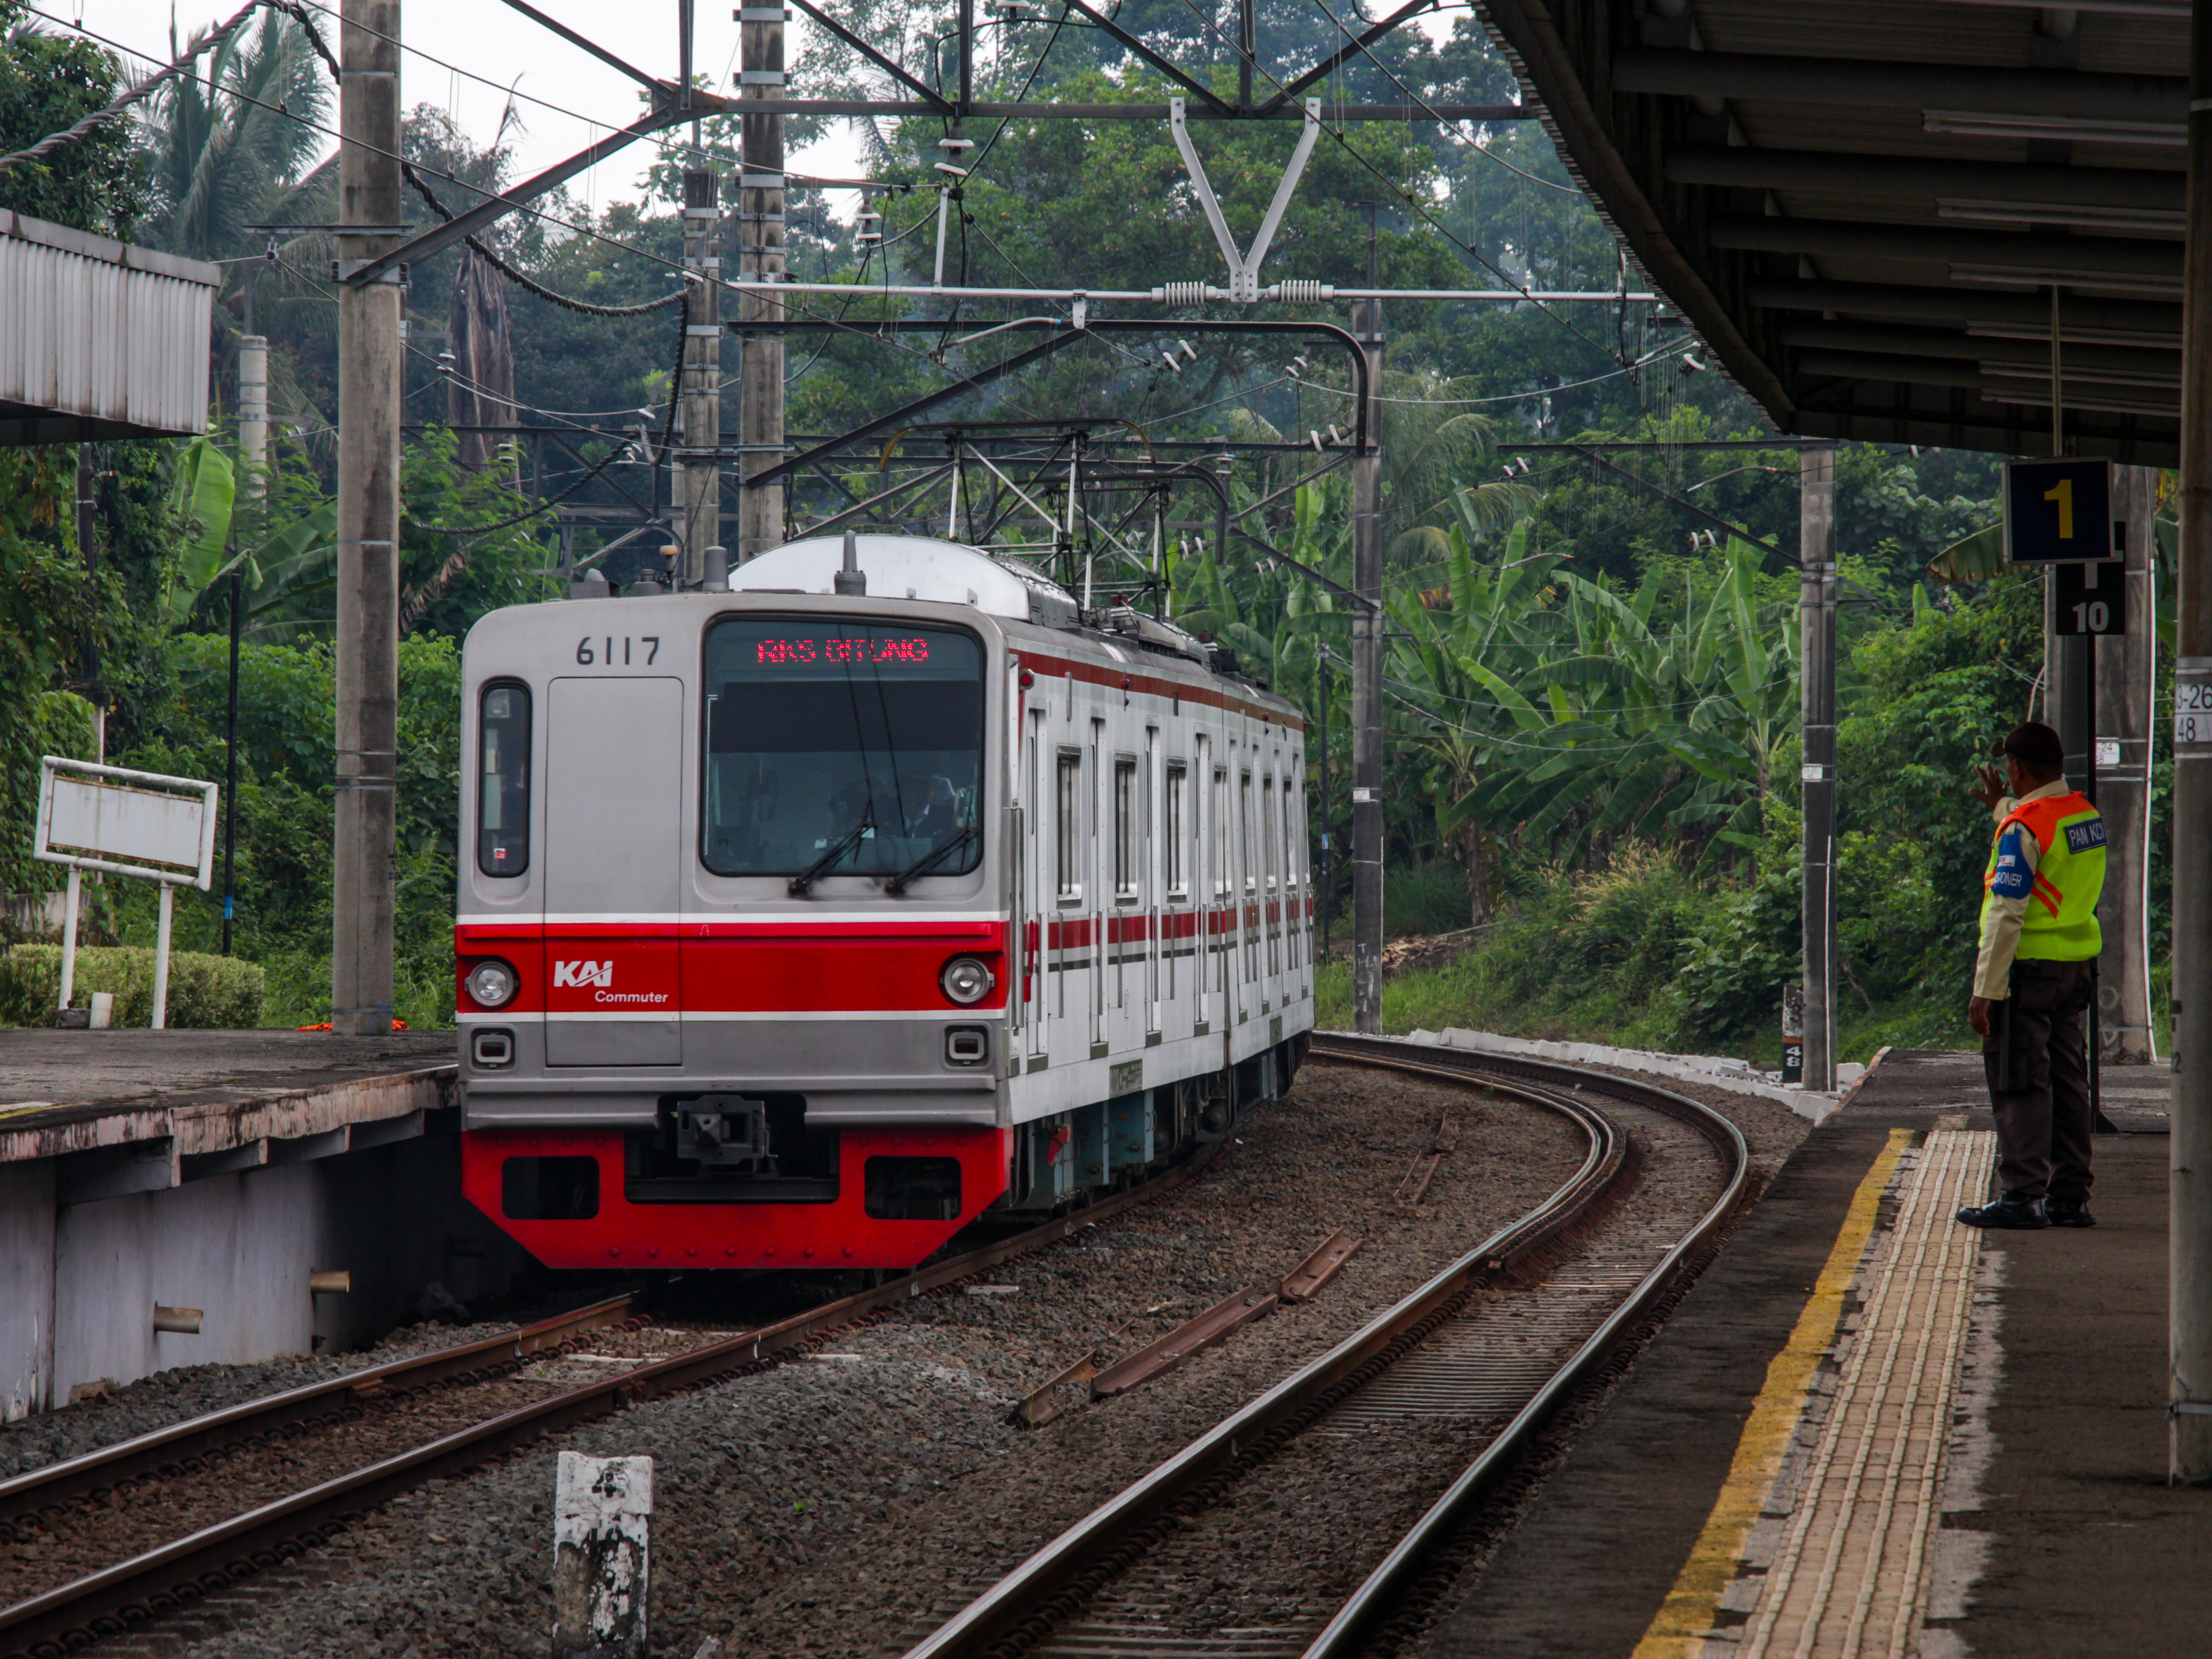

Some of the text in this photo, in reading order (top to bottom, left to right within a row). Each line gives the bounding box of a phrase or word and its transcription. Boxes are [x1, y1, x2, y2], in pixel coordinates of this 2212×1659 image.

[2044, 479, 2073, 539] 1
[2072, 601, 2109, 633] 10
[577, 637, 659, 665] 6117
[2178, 717, 2196, 742] 48
[2089, 822, 2105, 842] KCI
[554, 961, 613, 987] KAI
[595, 990, 668, 1003] Commuter
